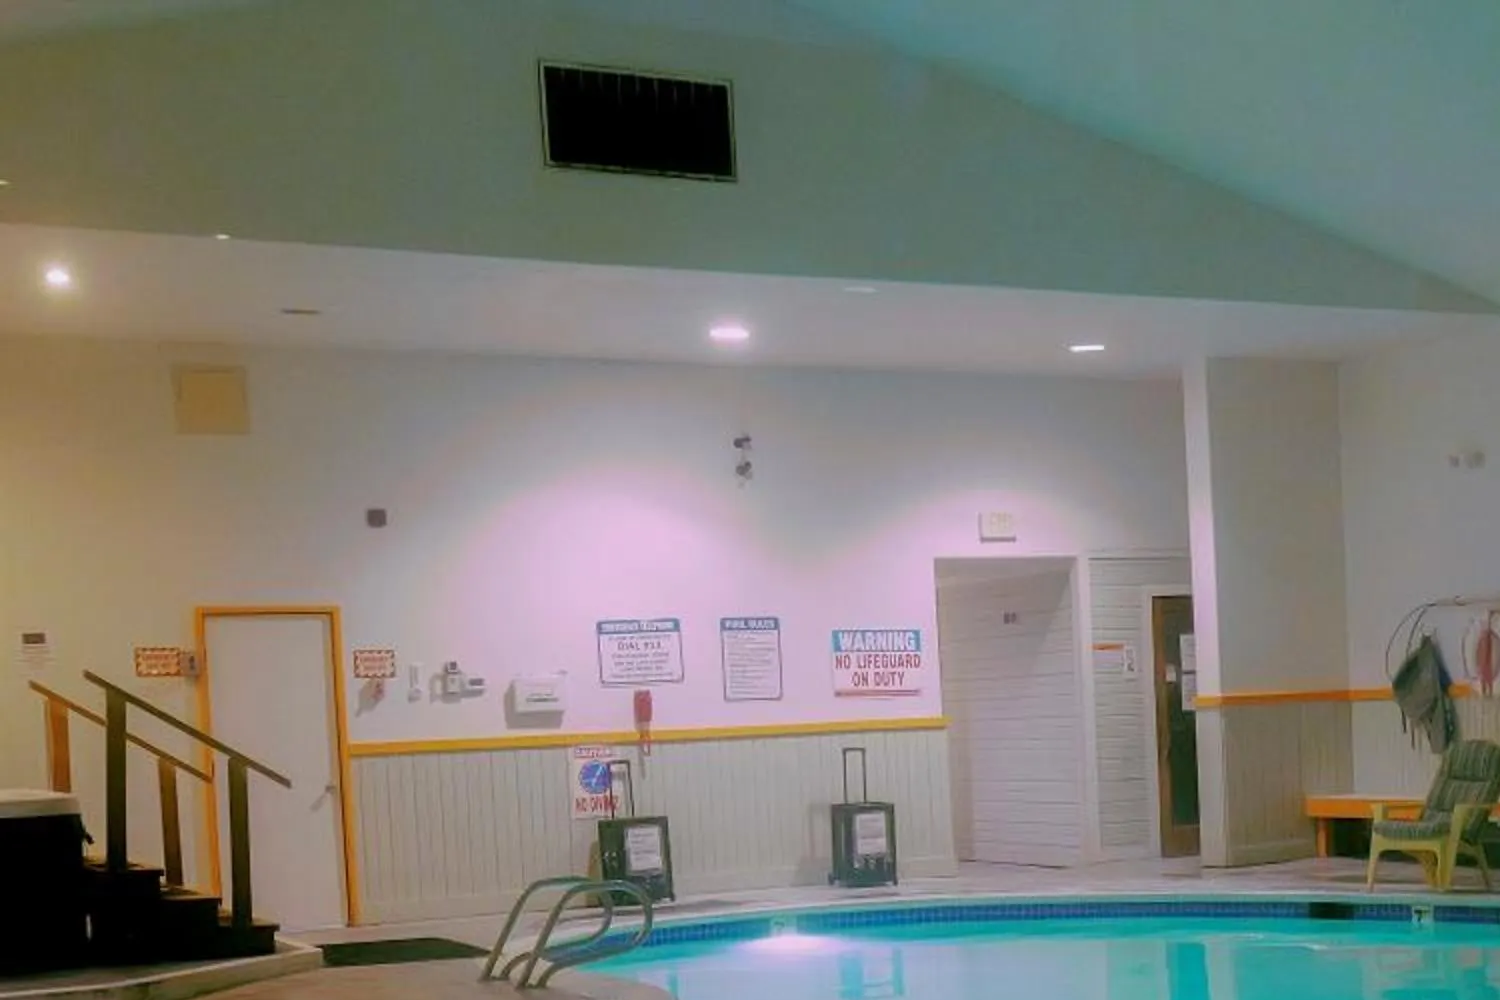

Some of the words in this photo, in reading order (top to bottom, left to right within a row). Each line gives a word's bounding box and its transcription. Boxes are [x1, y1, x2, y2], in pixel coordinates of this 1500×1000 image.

[839, 631, 916, 651] WARNING
[835, 654, 851, 669] NO
[857, 653, 921, 669] LIFEGUARD
[851, 671, 869, 686] ON
[874, 671, 905, 686] DUTY
